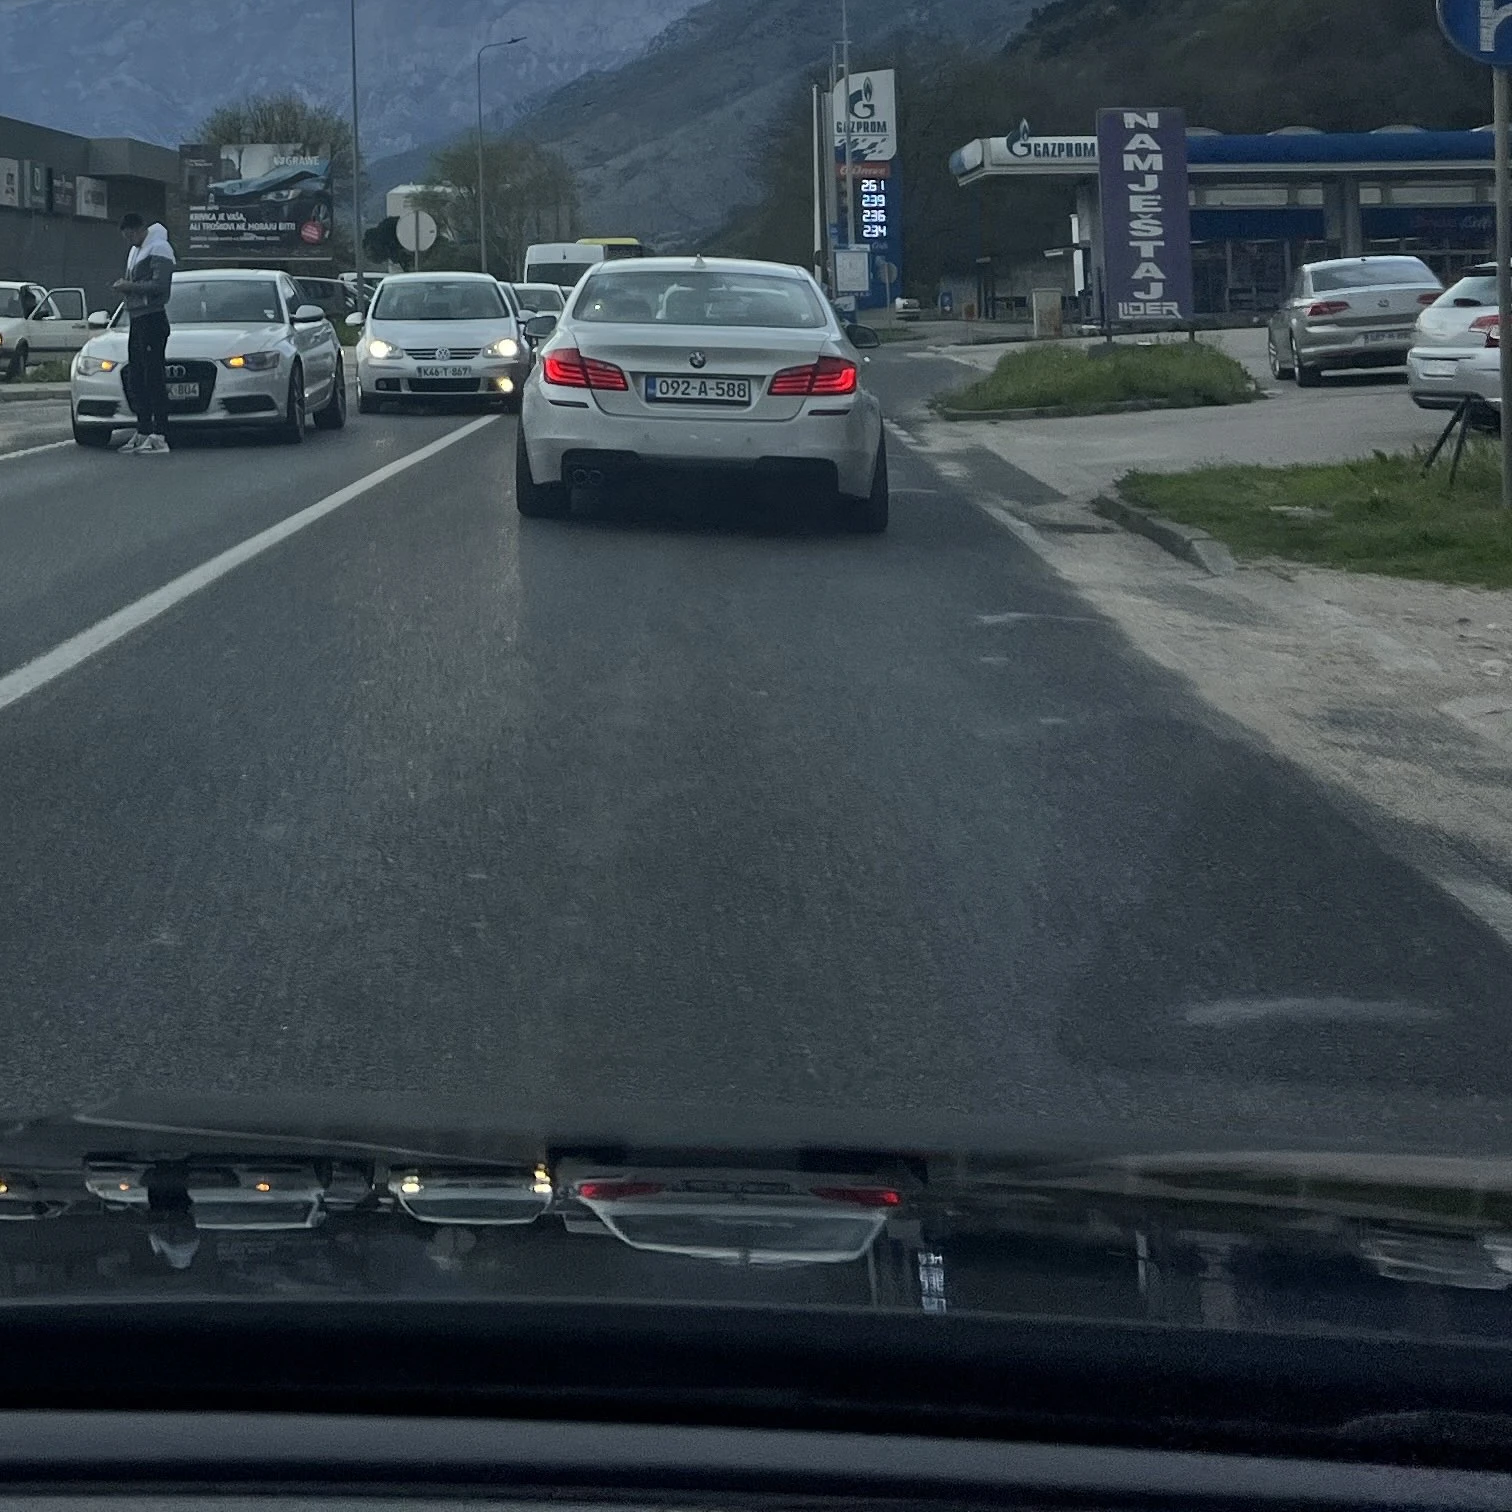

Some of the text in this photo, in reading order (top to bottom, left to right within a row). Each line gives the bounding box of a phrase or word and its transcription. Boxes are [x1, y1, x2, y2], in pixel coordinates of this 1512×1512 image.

[1033, 142, 1096, 158] GAZPROM
[1122, 112, 1166, 300] NAMJEŠTAJ
[1118, 301, 1183, 320] LIDER
[658, 379, 748, 399] 092-A-588
